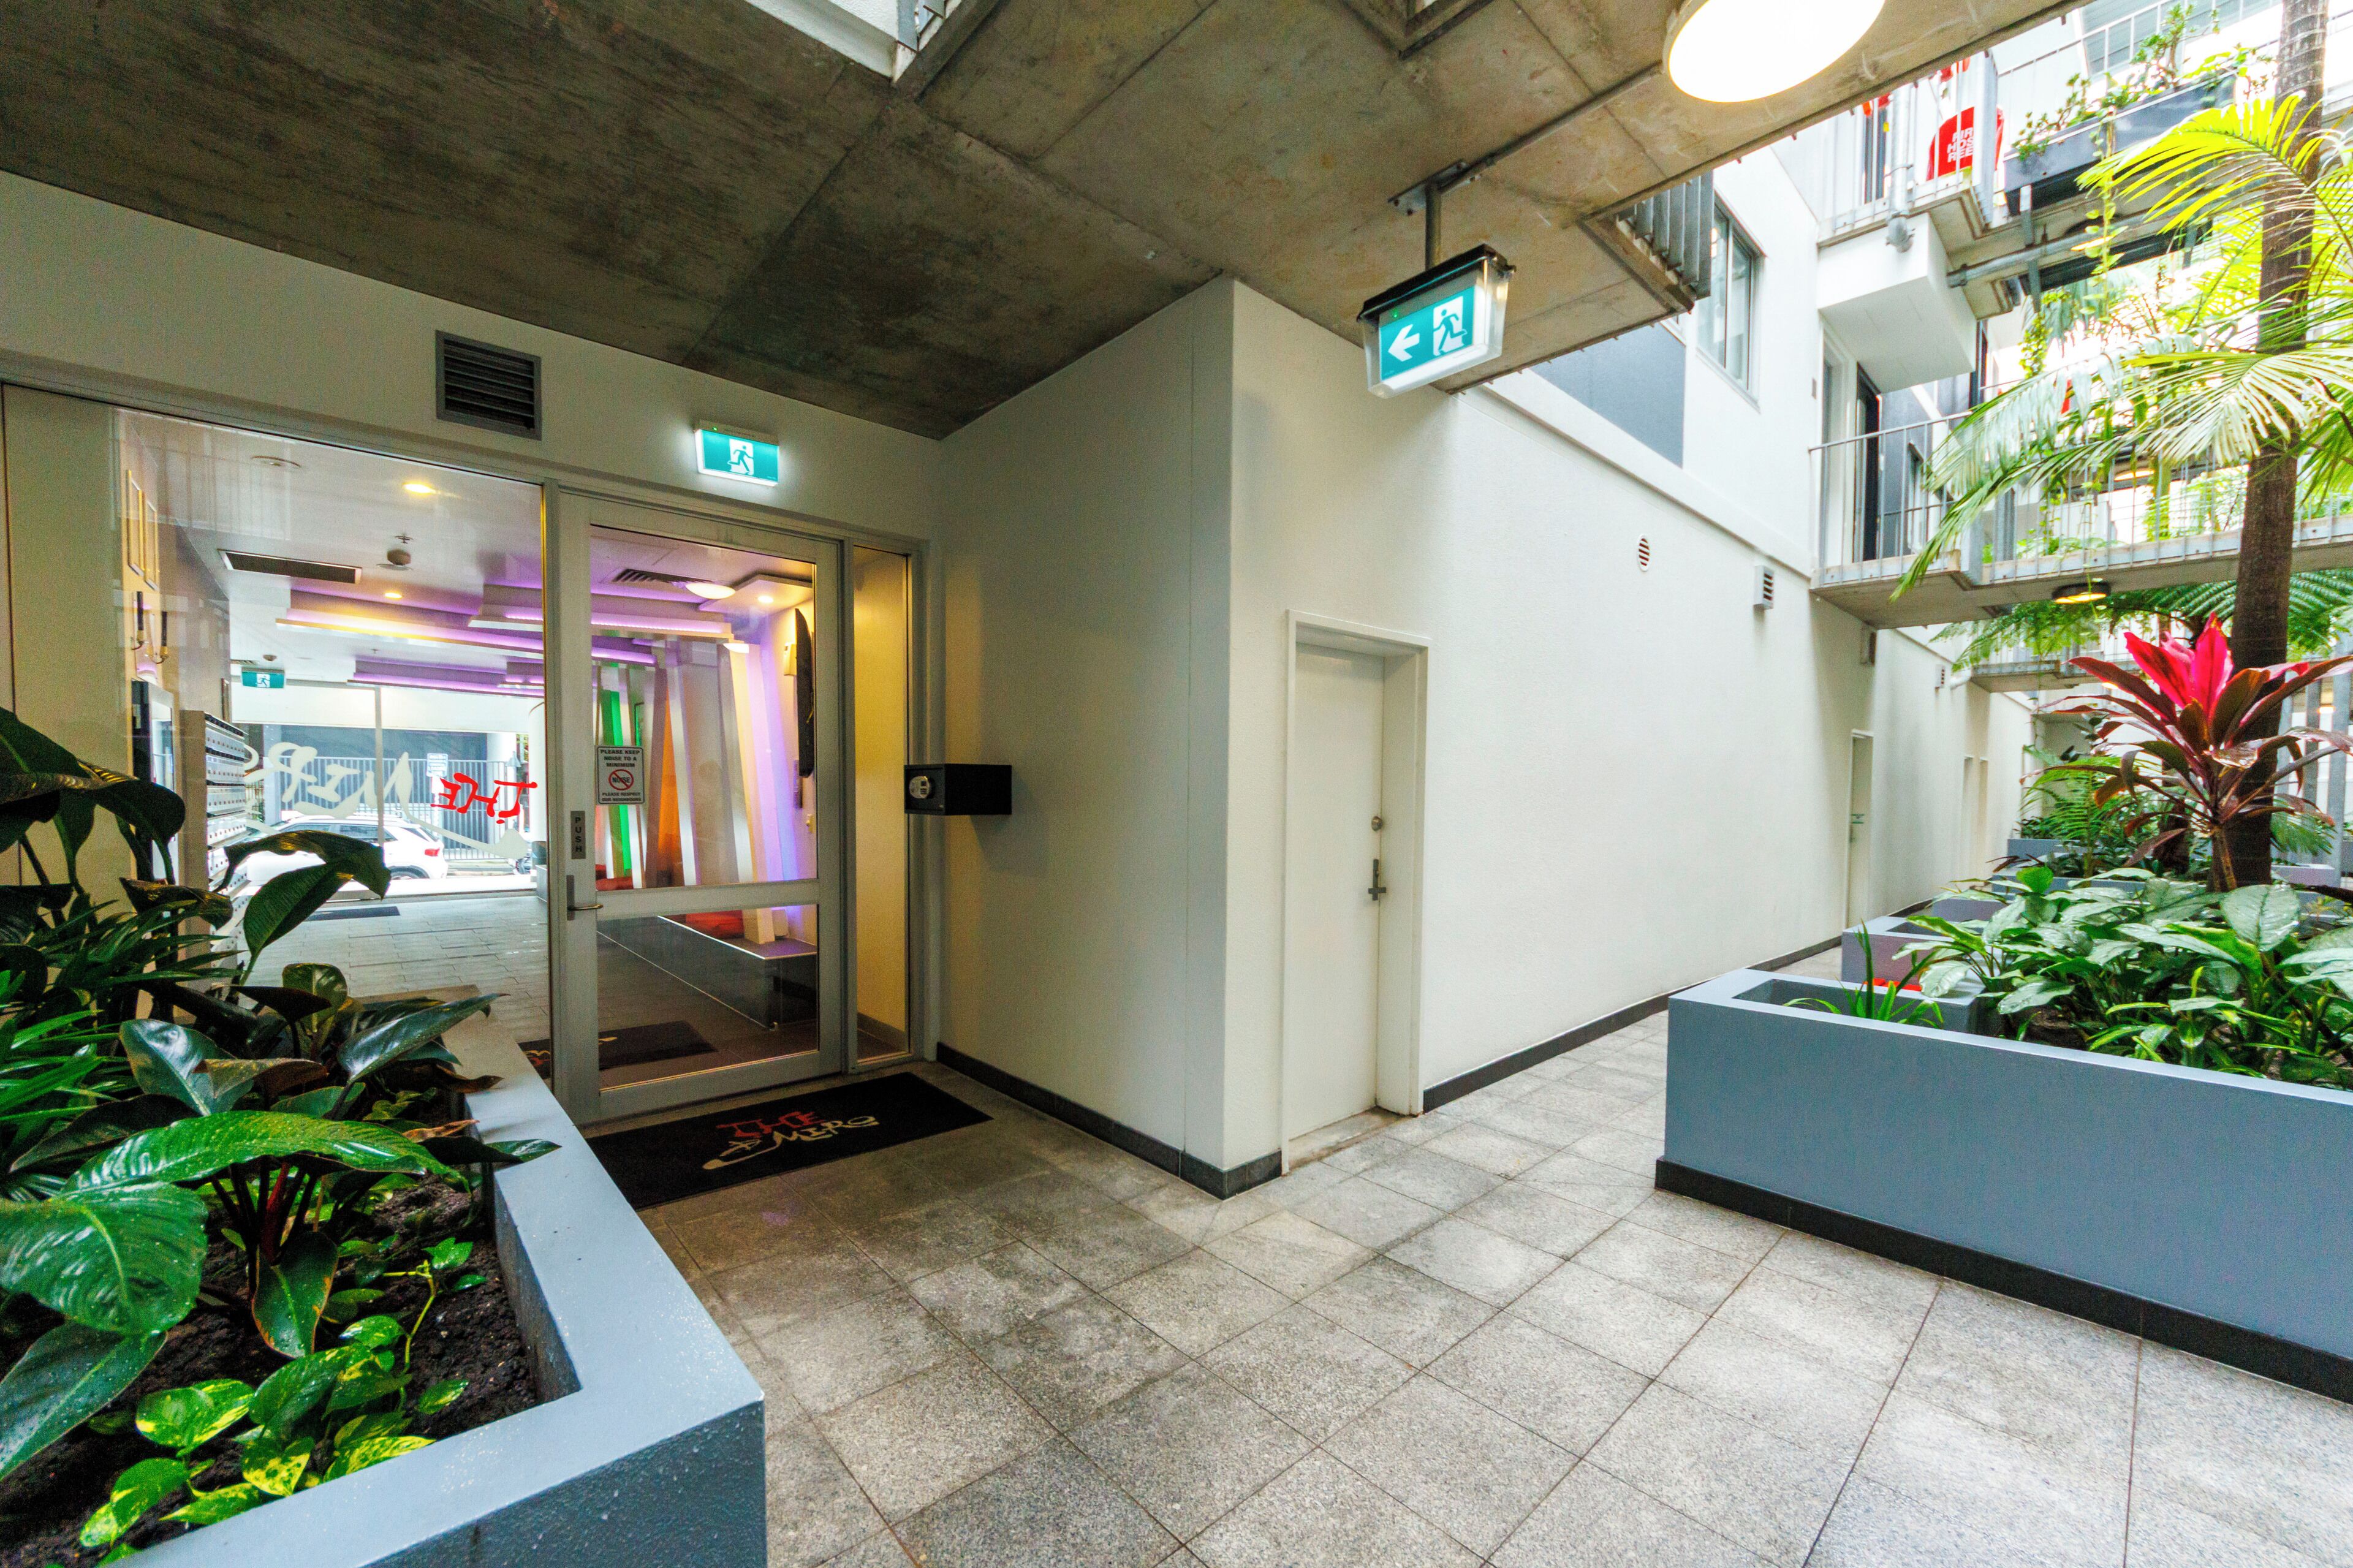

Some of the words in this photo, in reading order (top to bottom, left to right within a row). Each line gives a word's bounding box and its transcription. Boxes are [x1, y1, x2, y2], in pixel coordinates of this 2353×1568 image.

[1952, 127, 1974, 143] FIR
[1947, 137, 1974, 154] HOS
[1947, 146, 1973, 163] REE
[716, 1111, 827, 1138] THE
